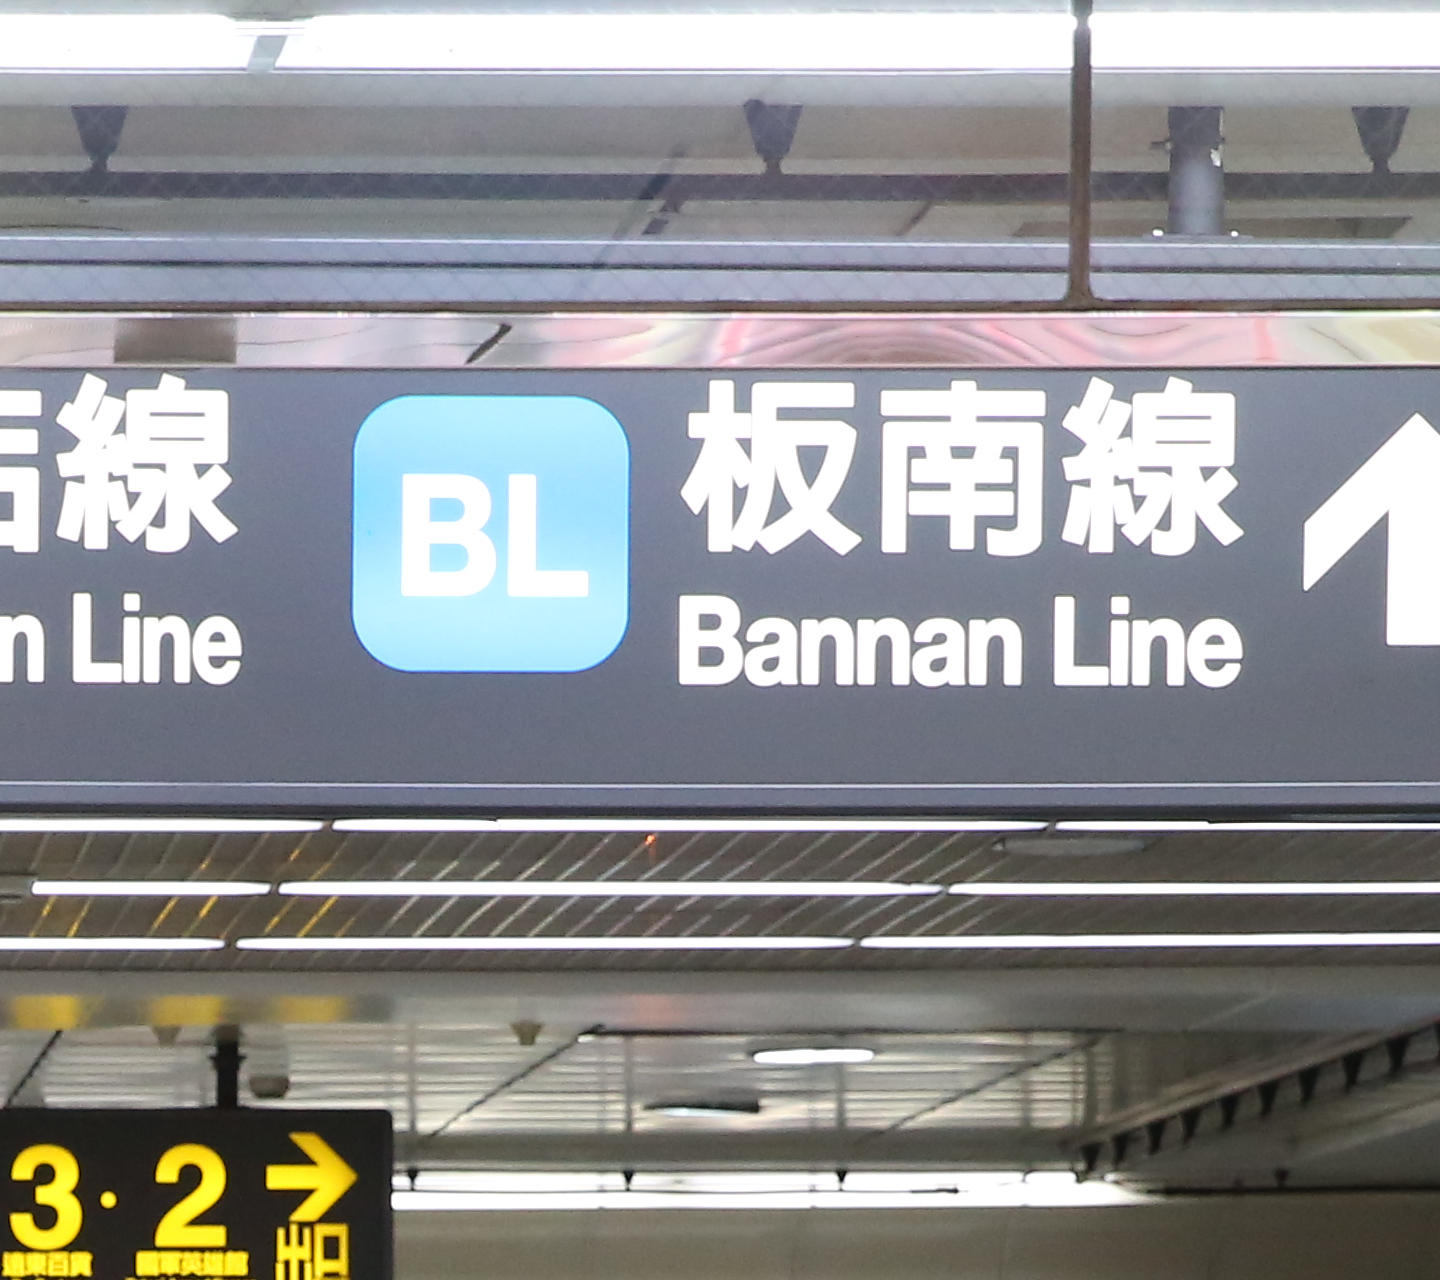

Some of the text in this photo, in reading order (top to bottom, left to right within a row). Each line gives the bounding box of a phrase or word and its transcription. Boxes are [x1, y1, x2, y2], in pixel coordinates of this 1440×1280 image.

[681, 377, 1243, 556] 板南線
[401, 474, 588, 596] BL
[72, 593, 242, 685] Line
[679, 596, 1243, 687] Bannan Line
[8, 1143, 227, 1251] 3 2
